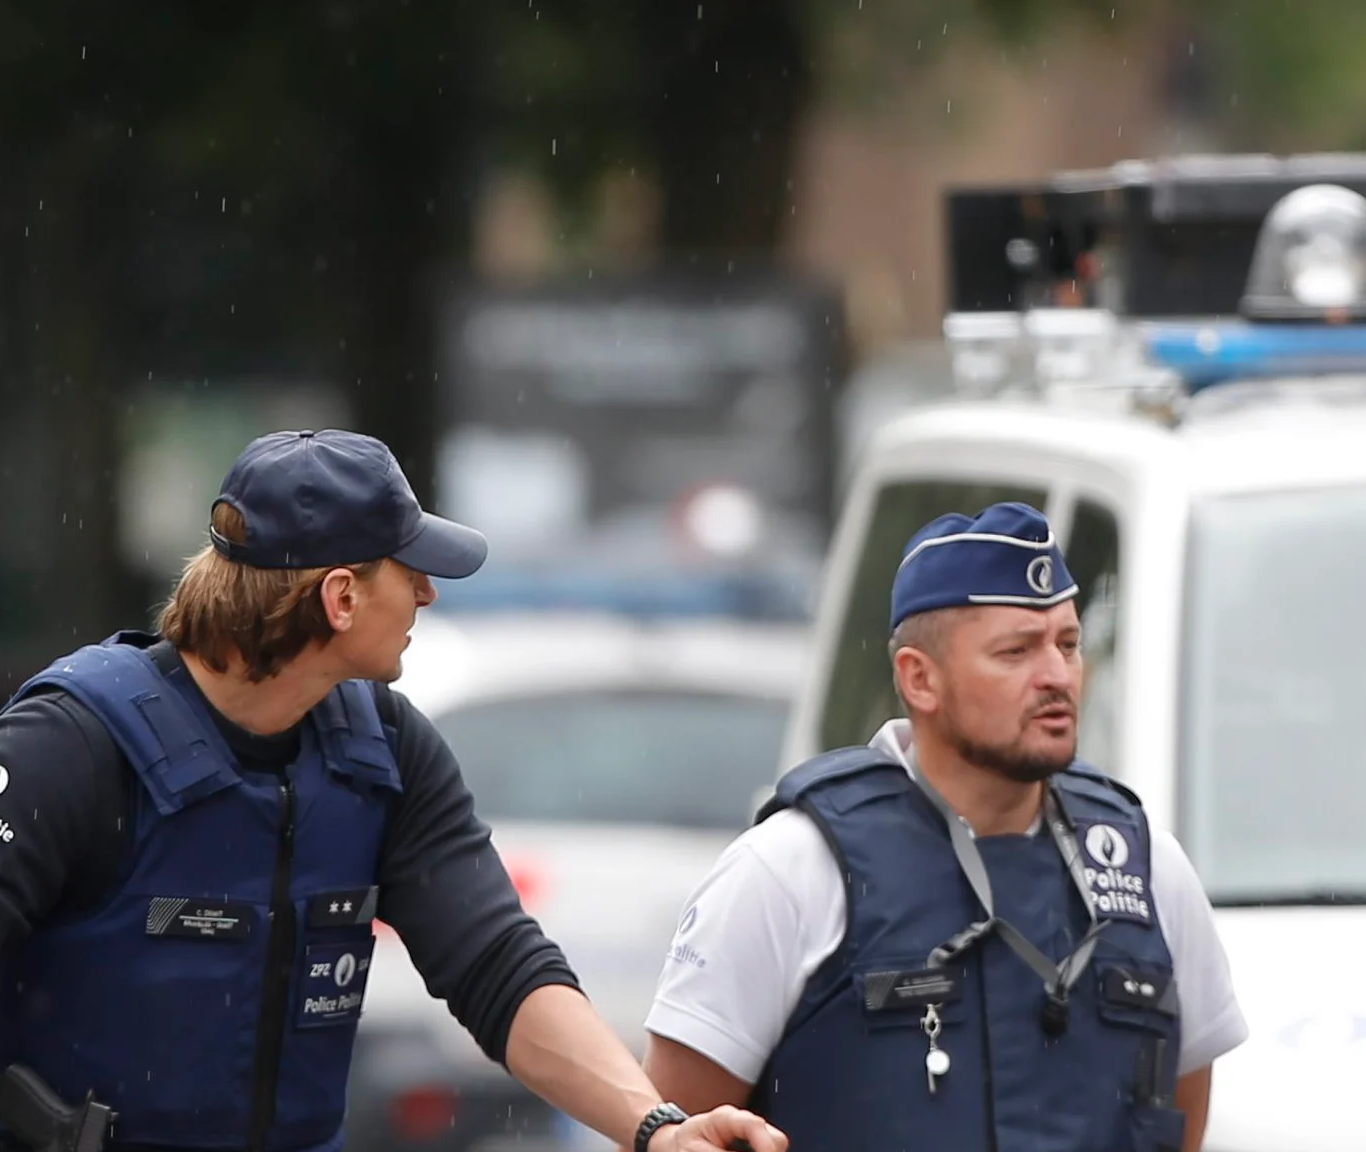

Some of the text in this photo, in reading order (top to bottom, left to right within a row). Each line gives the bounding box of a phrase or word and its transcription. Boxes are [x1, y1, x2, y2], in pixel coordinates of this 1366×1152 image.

[1083, 867, 1144, 894] Police
[673, 943, 708, 969] olitie
[304, 995, 336, 1014] Police
